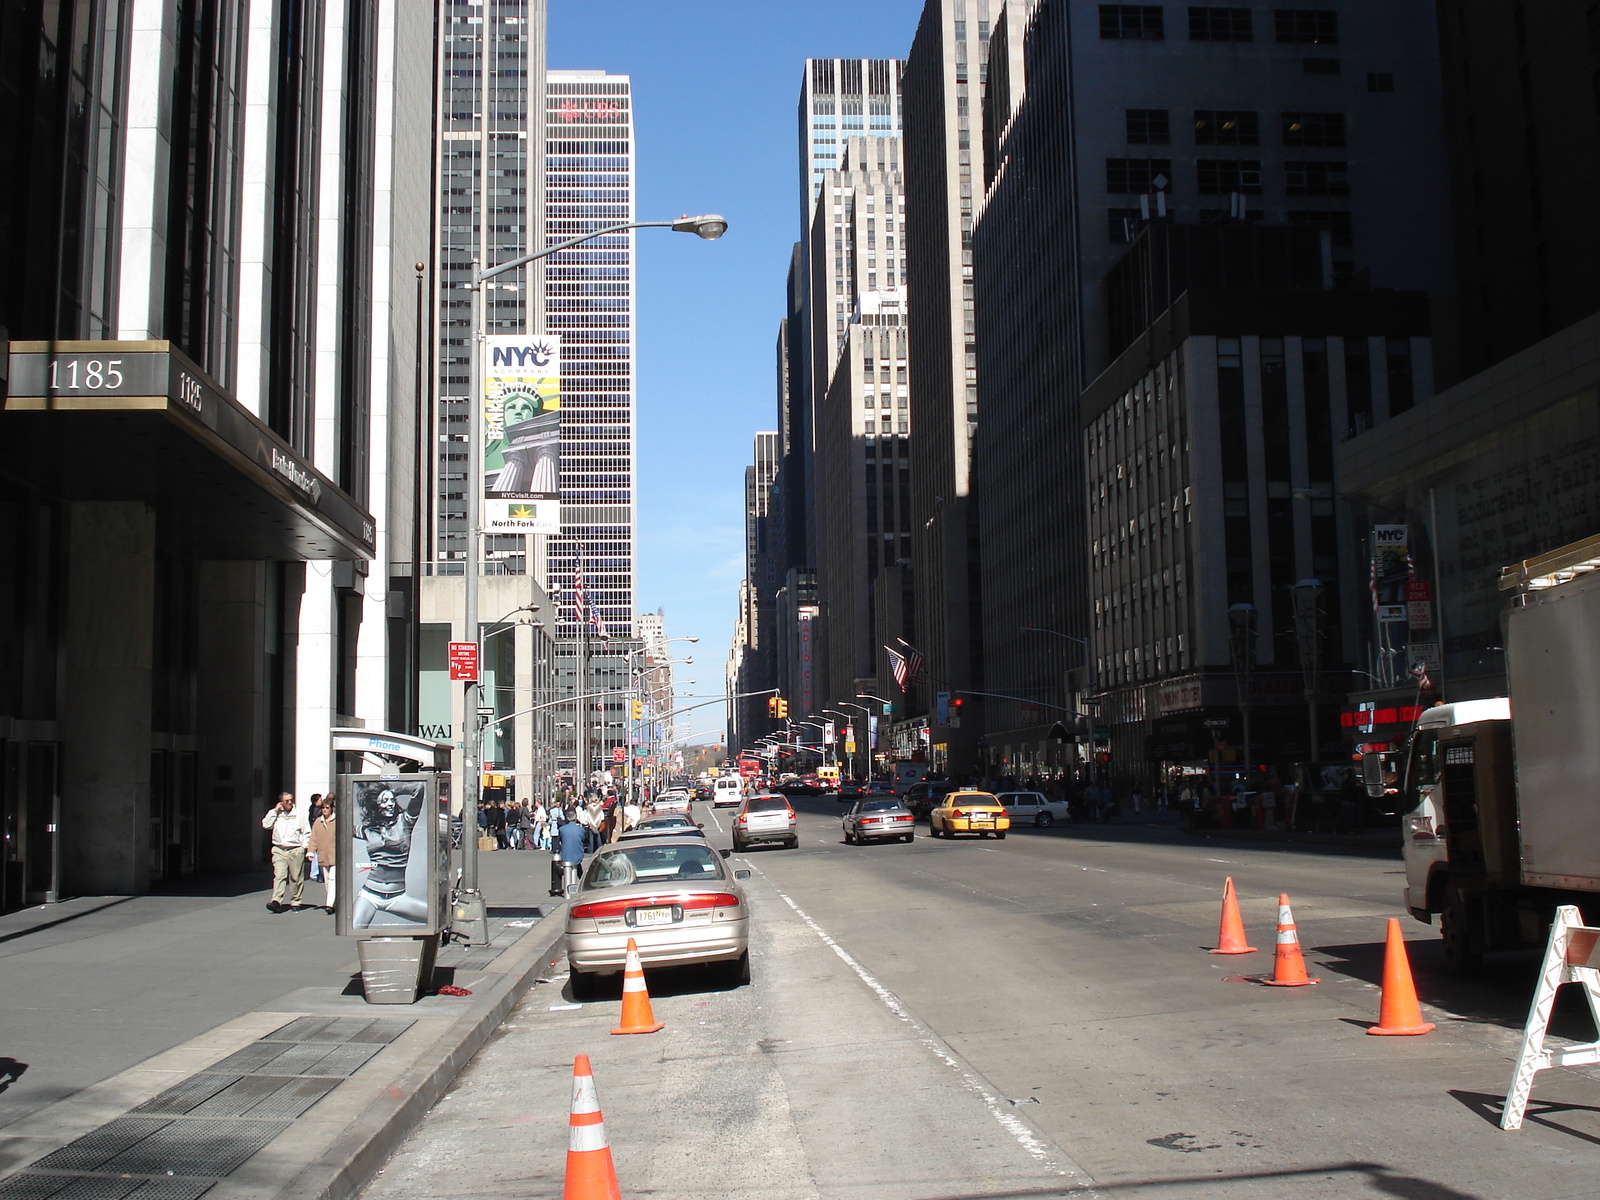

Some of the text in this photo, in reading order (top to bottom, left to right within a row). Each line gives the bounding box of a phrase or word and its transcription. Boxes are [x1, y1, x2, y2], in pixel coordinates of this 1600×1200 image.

[493, 343, 551, 367] NYC
[48, 360, 123, 389] 1185
[180, 372, 202, 412] 1185
[487, 381, 504, 440] BANKING
[517, 520, 535, 528] Fork
[1377, 529, 1403, 541] NYC
[1410, 582, 1425, 590] RED
[1409, 591, 1427, 600] ZONE
[1411, 644, 1434, 652] BUSES
[802, 615, 811, 708] RADIO CITY
[1248, 679, 1325, 695] DIAMO
[368, 738, 401, 751] Phone
